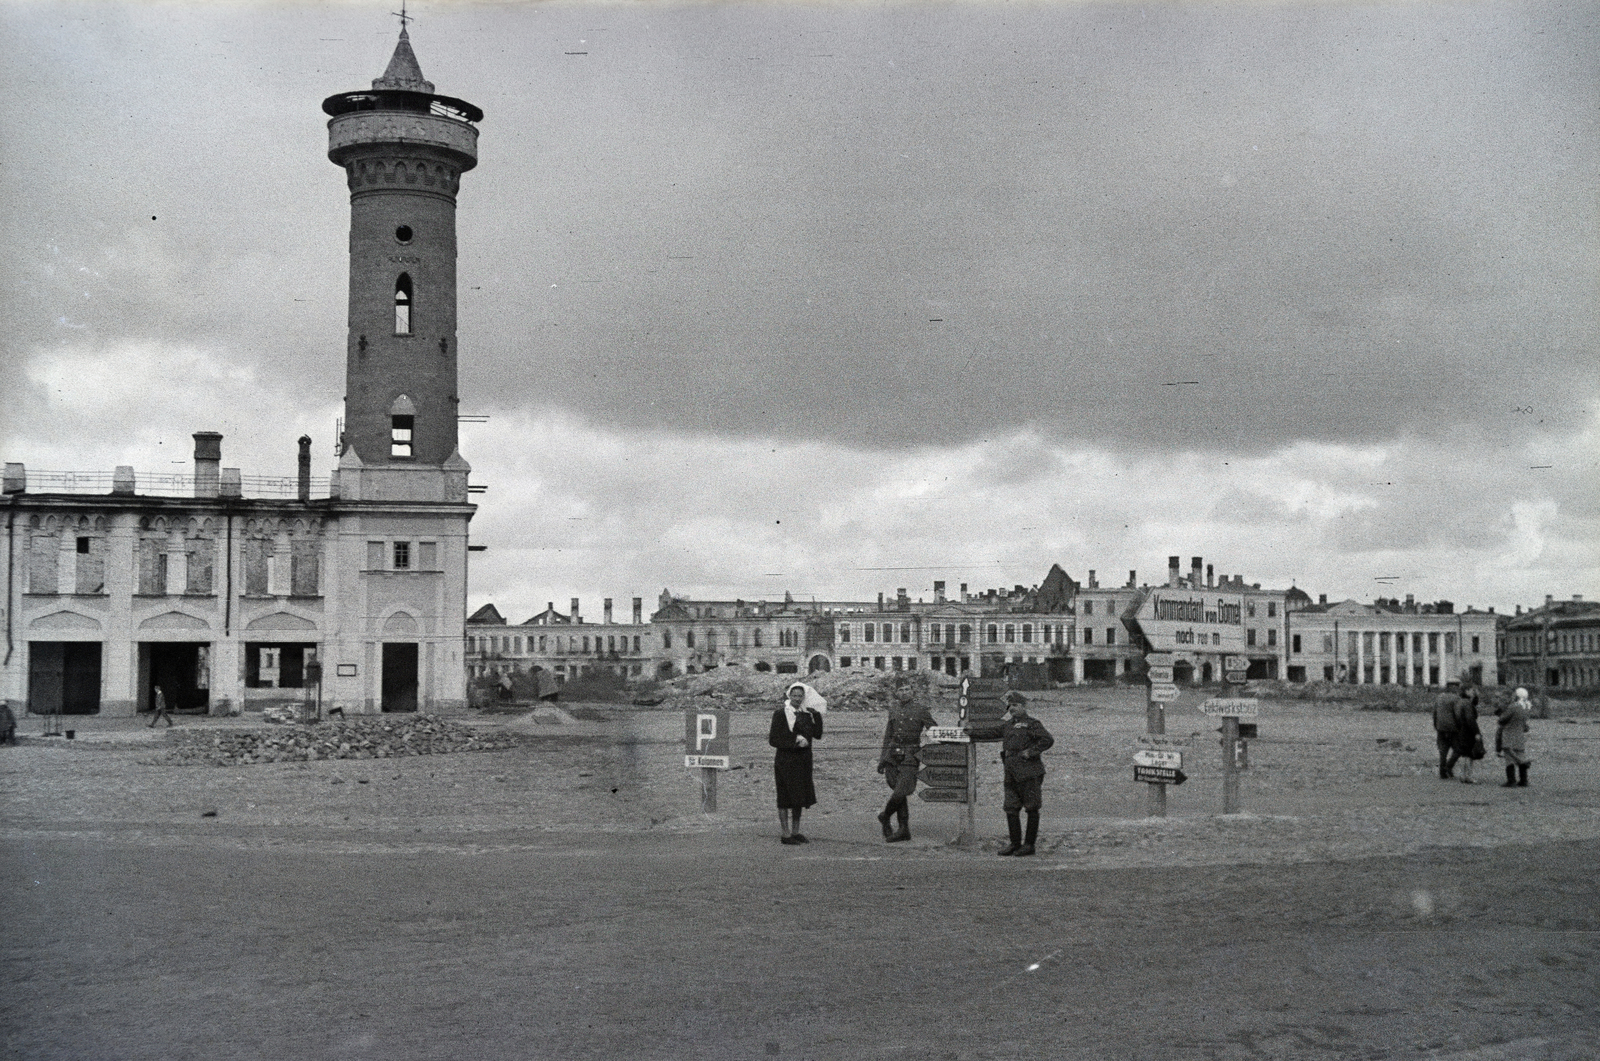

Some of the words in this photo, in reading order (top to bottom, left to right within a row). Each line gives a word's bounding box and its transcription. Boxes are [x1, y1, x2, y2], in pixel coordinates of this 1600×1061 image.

[1154, 594, 1204, 622] Kommandant
[1205, 611, 1217, 624] von
[1218, 598, 1241, 625] Gomel
[1176, 627, 1194, 644] noch
[1213, 632, 1220, 645] m
[696, 713, 717, 751] P
